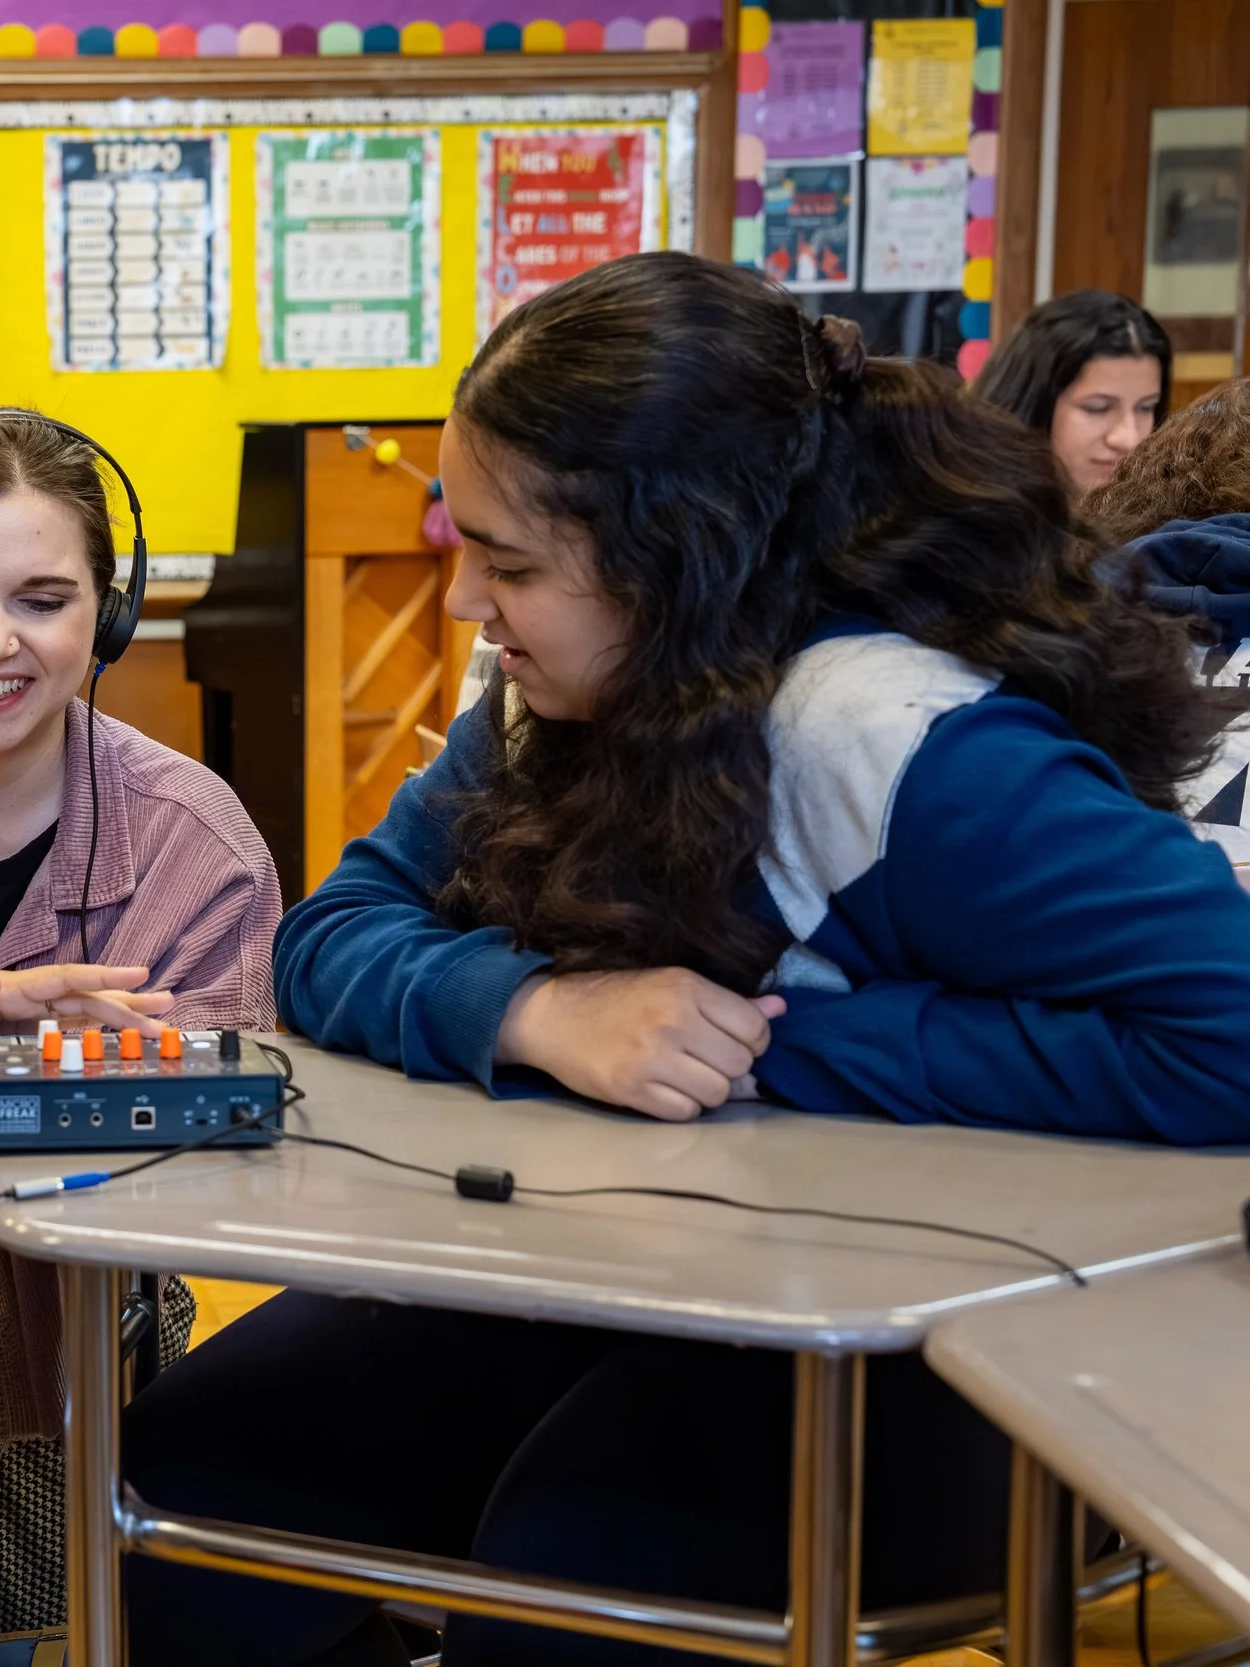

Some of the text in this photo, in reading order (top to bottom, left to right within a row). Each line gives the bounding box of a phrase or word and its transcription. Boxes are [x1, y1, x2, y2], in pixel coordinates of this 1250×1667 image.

[93, 144, 182, 173] TEMPO
[561, 154, 597, 175] YOU
[537, 213, 568, 234] ALL
[571, 212, 607, 234] THE
